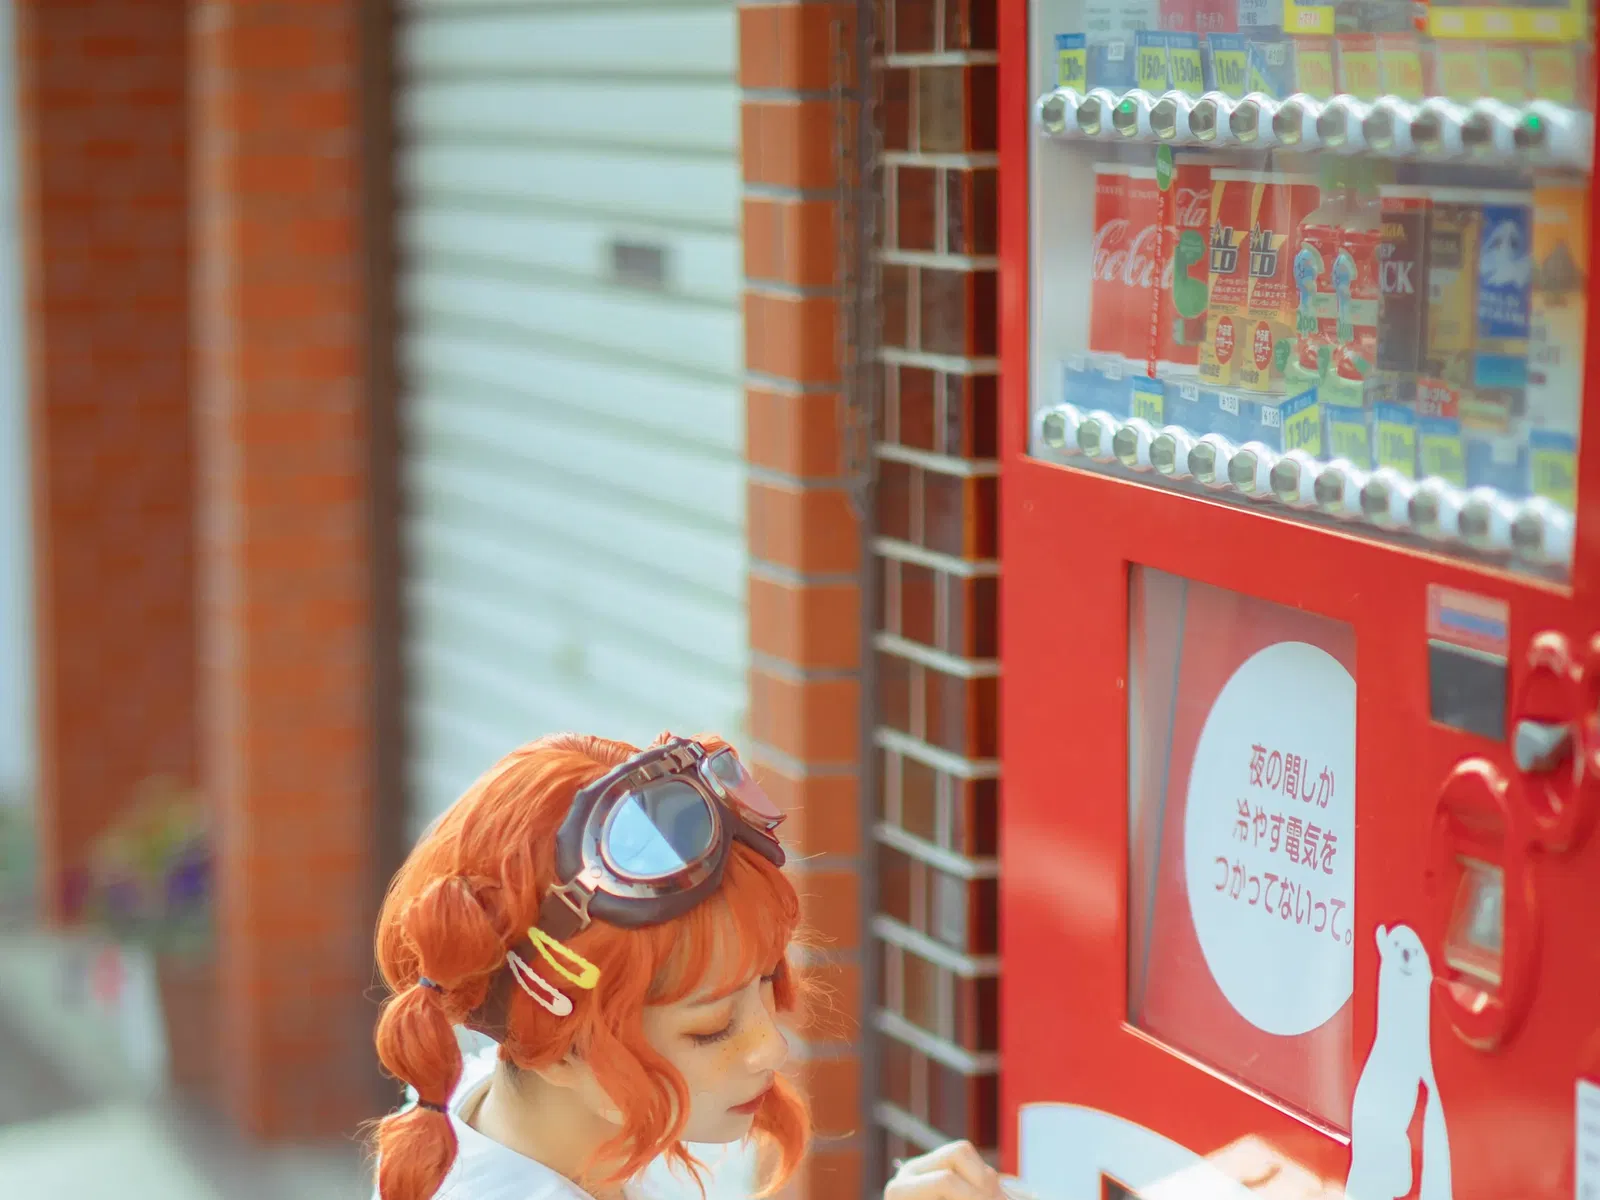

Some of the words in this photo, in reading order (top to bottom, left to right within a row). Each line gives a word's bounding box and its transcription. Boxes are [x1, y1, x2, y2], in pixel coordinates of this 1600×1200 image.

[1249, 742, 1335, 809] 夜の間しか
[1232, 798, 1338, 875] 冷やす電気を
[1214, 855, 1352, 946] つかってないって。
